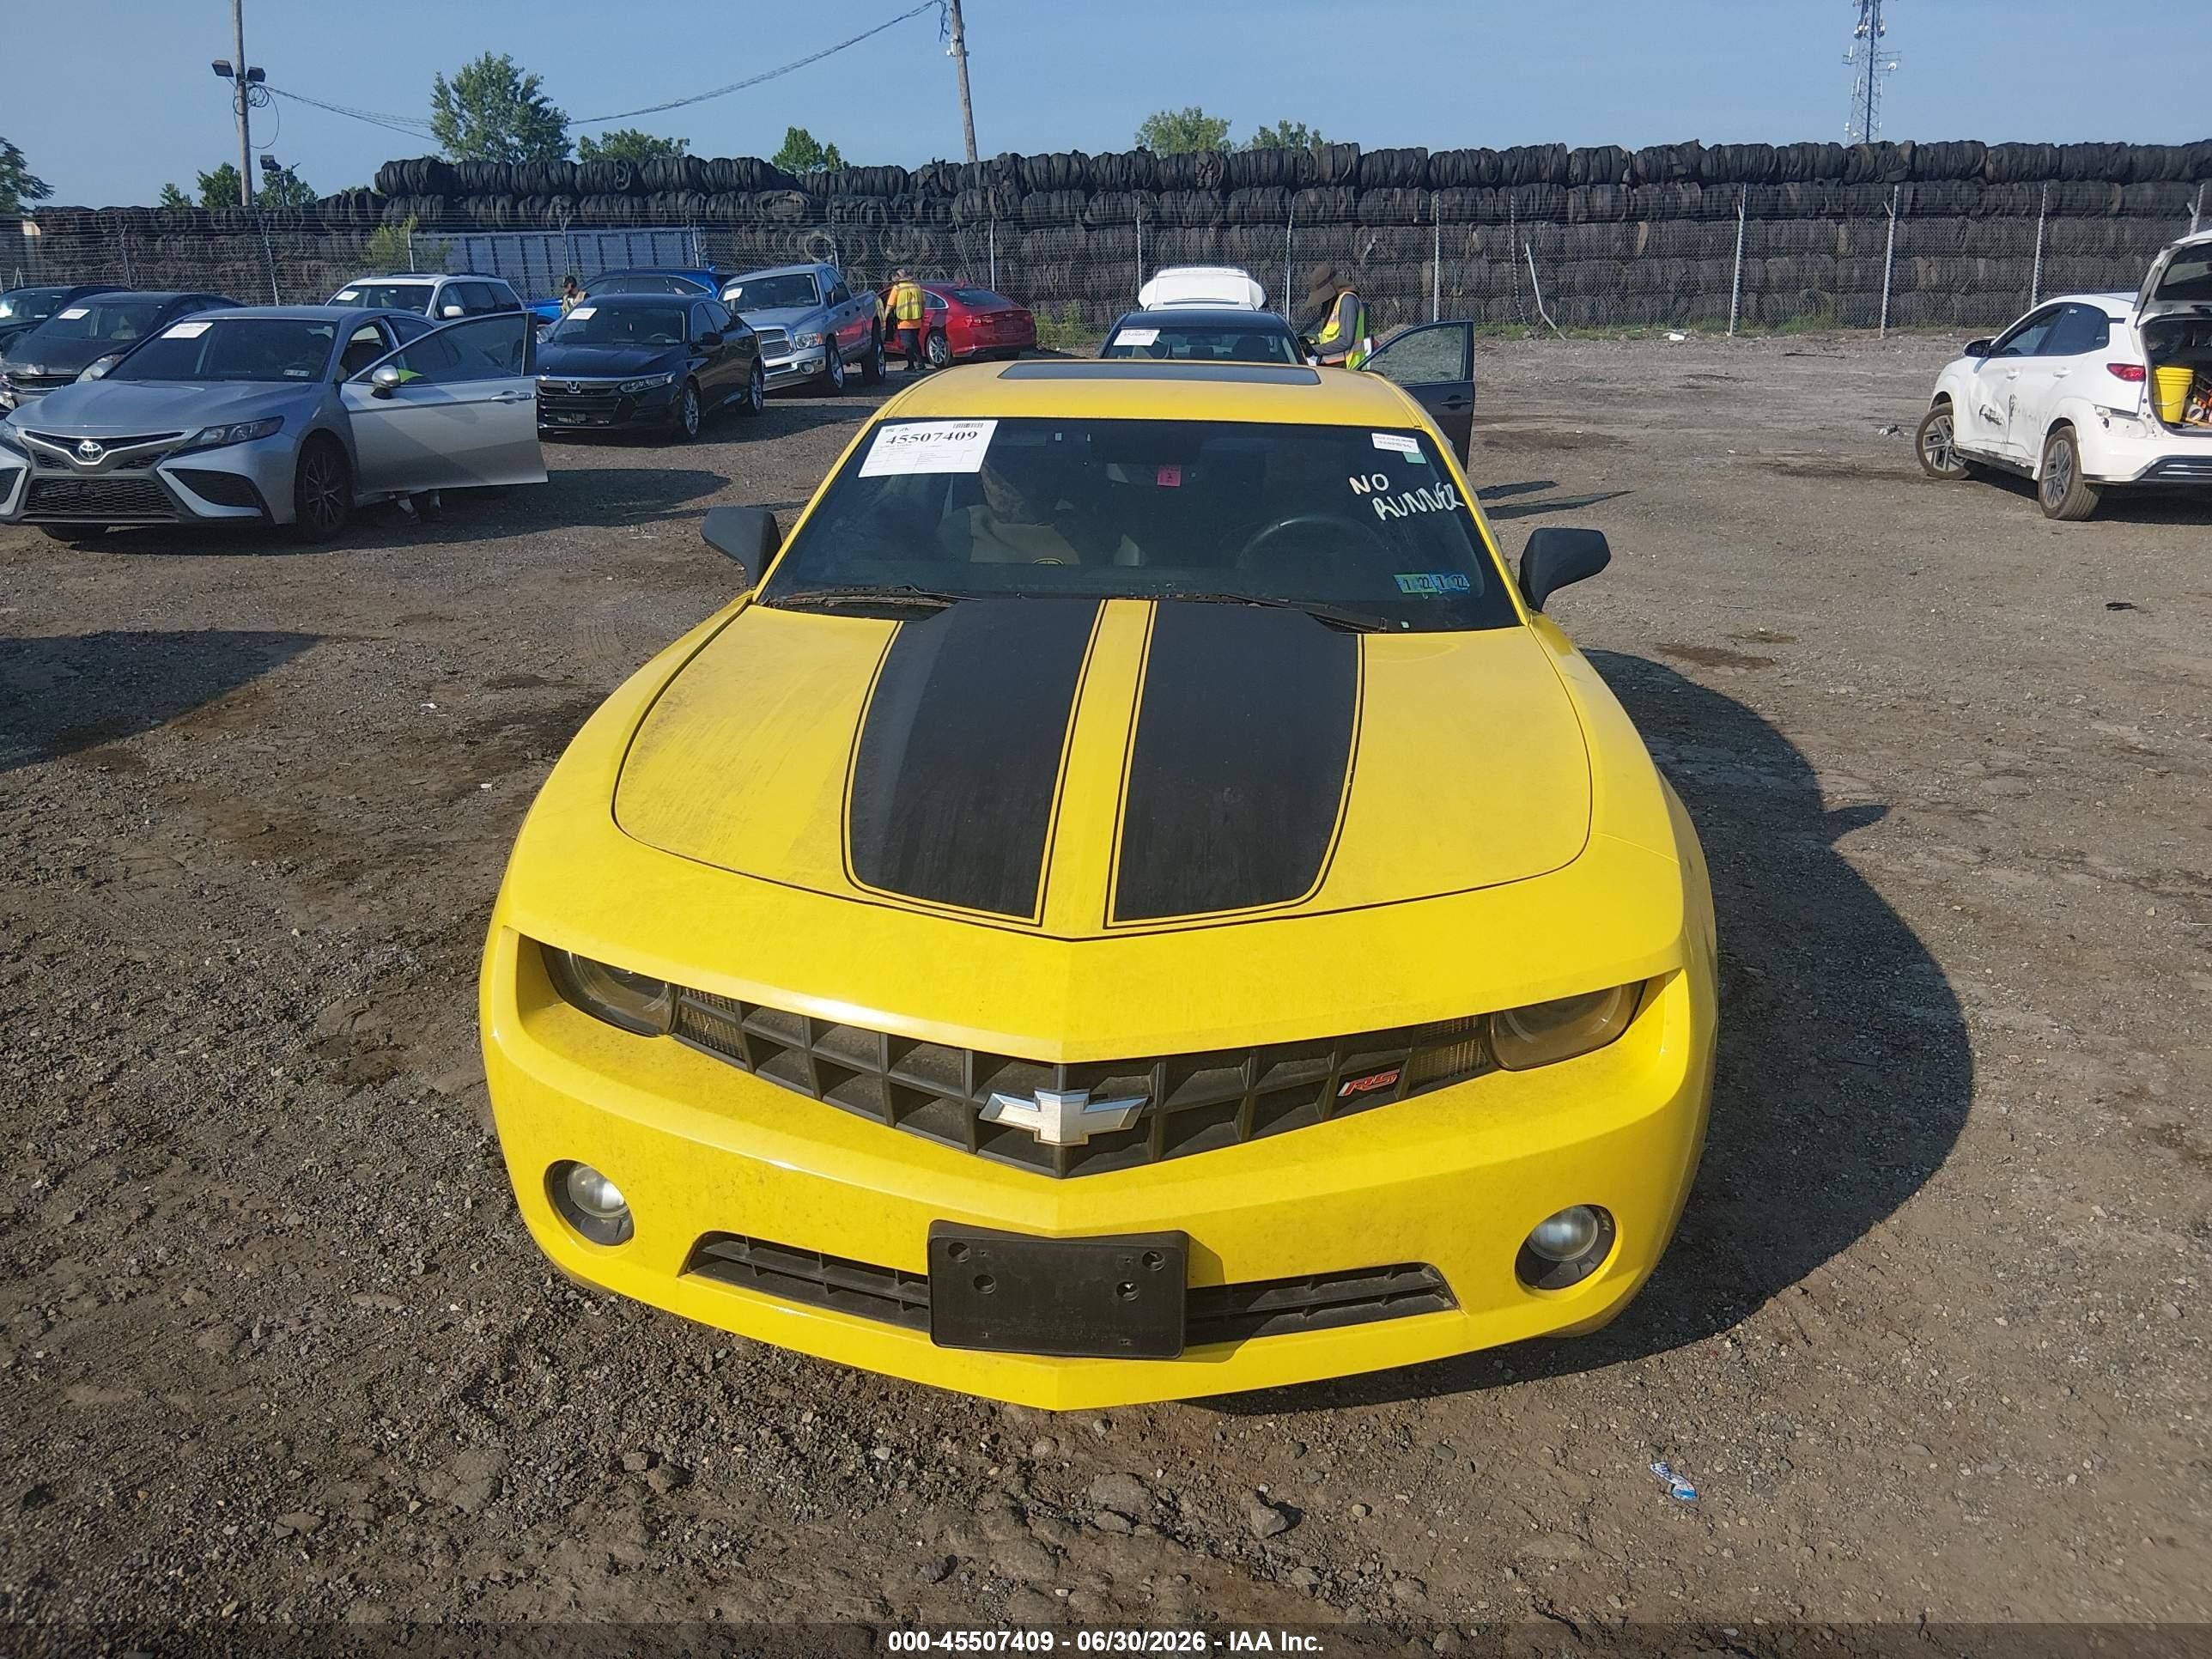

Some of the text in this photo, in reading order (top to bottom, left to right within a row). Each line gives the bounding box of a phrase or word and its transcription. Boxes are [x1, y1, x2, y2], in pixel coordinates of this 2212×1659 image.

[886, 430, 978, 445] 45507409
[1349, 473, 1389, 495] NO
[1371, 482, 1466, 520] RUNNER
[1338, 1068, 1401, 1097] RS
